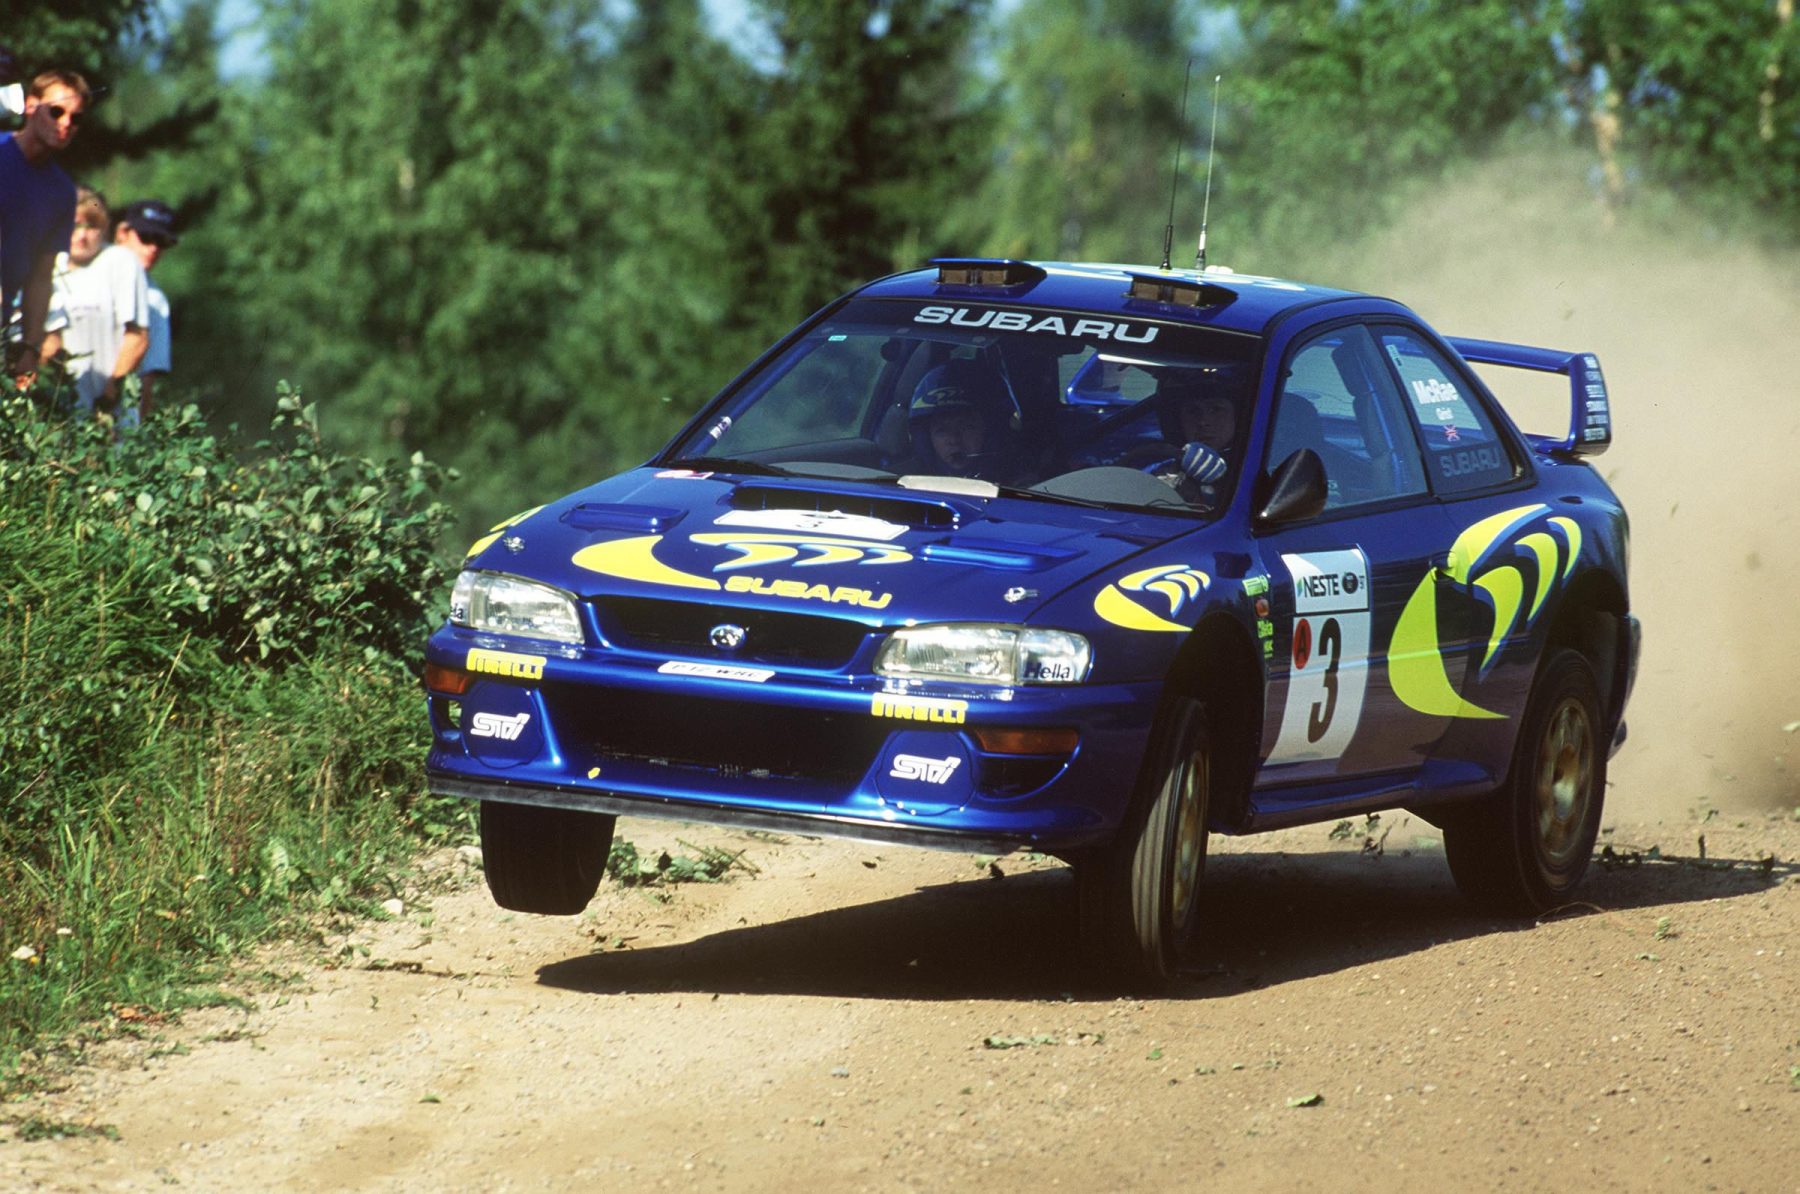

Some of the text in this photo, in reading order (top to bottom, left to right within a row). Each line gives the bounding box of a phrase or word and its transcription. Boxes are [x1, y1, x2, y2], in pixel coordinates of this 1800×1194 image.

[914, 306, 1159, 344] SUBARU
[1440, 446, 1500, 477] SUBARU
[725, 576, 892, 609] SUBARU
[1303, 573, 1340, 598] NESTE
[466, 648, 547, 680] PIRELLI
[1023, 651, 1070, 680] Hella
[1308, 617, 1341, 743] 3
[871, 692, 969, 724] PIRELLI
